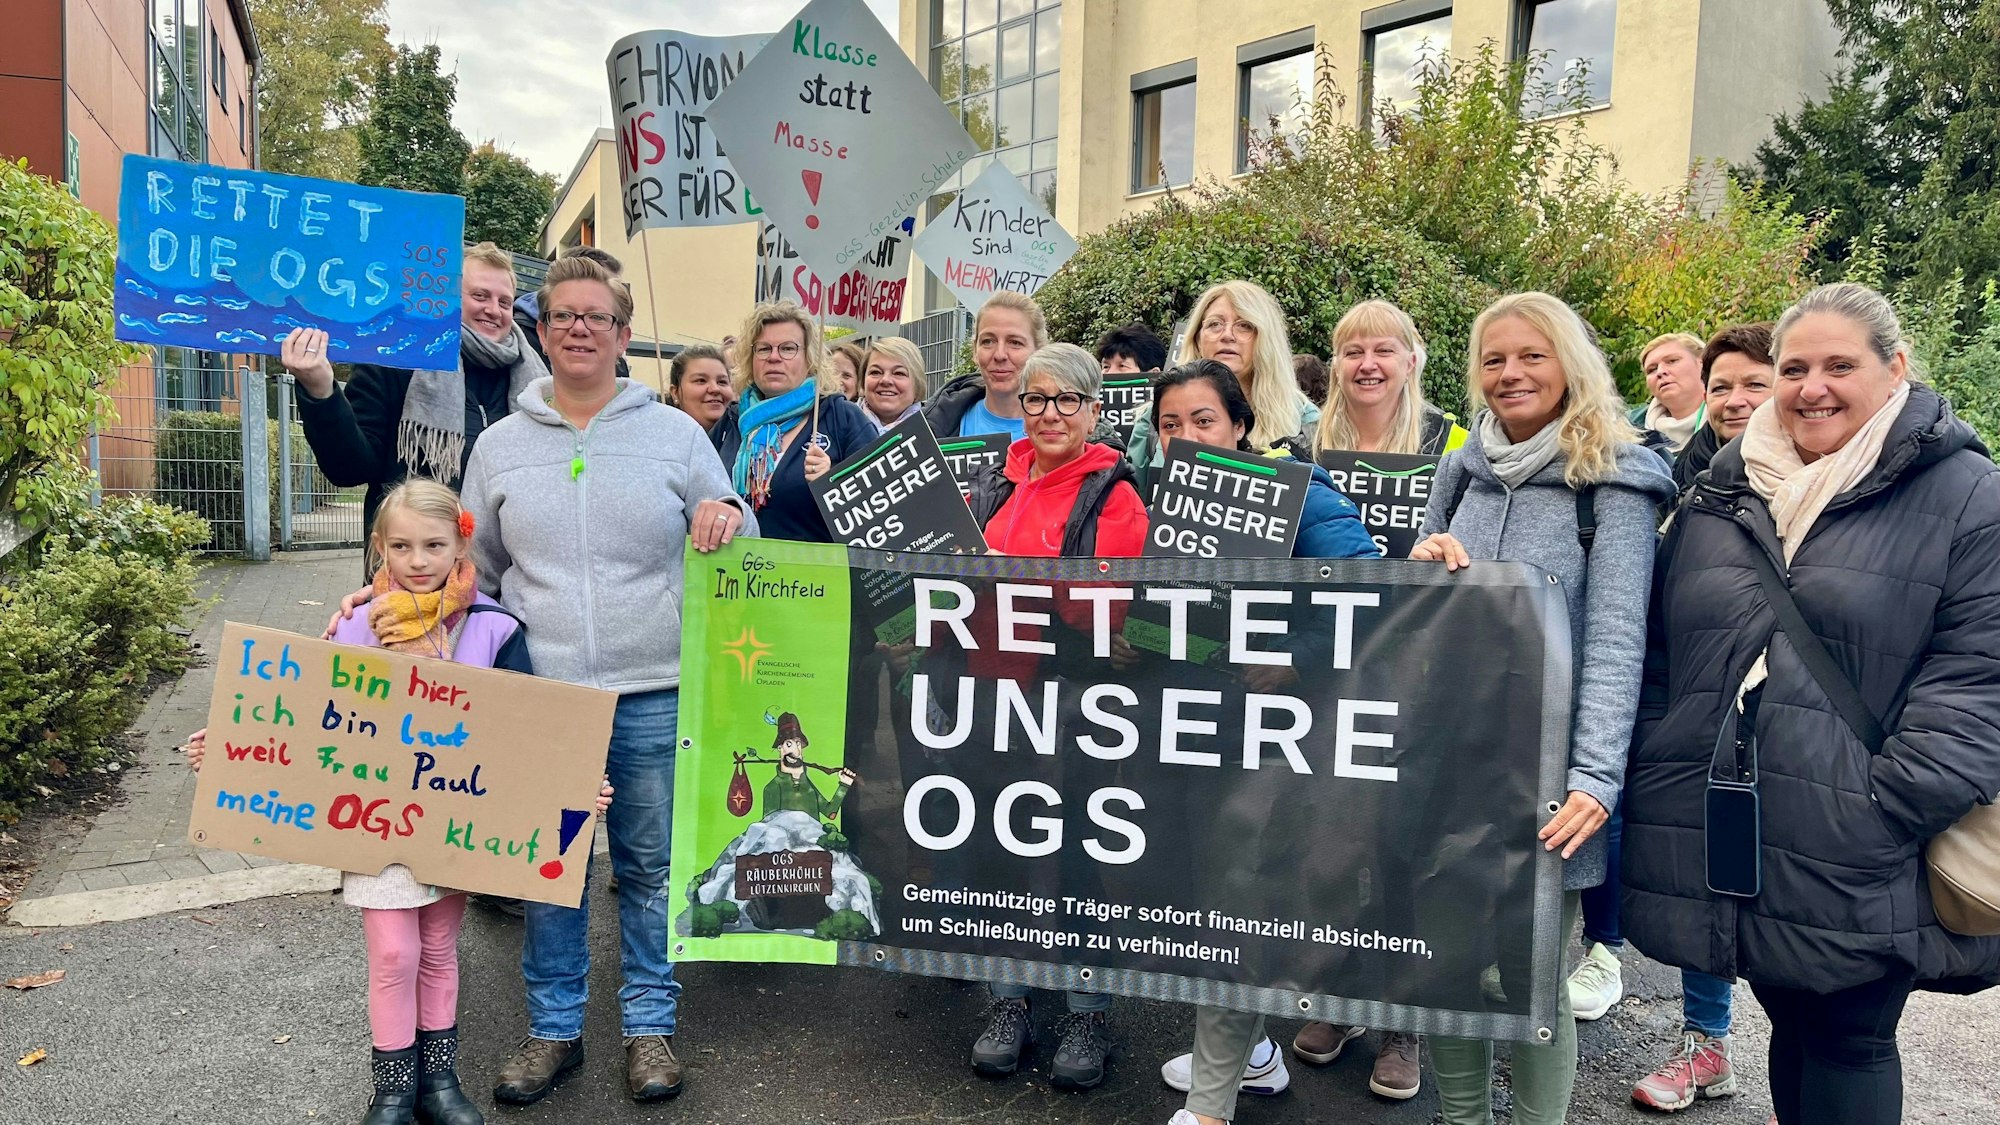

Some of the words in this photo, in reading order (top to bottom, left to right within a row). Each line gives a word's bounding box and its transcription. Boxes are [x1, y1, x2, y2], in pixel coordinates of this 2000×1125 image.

[793, 19, 877, 67] Klasse
[800, 73, 871, 114] statt
[675, 110, 706, 160] IST
[774, 120, 848, 160] Masse
[147, 170, 383, 242] RETTET
[679, 166, 736, 221] FÜR
[954, 194, 1050, 238] Kinder
[149, 227, 238, 283] DIE
[270, 247, 389, 308] OGS
[403, 241, 448, 267] SOS
[1031, 240, 1057, 255] OGS
[402, 268, 449, 295] SOS
[945, 256, 1048, 294] MEHRWERT
[402, 292, 448, 319] SOS
[822, 435, 919, 513] RETTET
[833, 456, 942, 535] UNSERE
[1168, 459, 1290, 507] RETTET
[1329, 470, 1435, 498] RETTE
[910, 531, 935, 548] Träger
[1154, 524, 1219, 558] OGS
[1161, 491, 1289, 543] UNSERE
[715, 568, 738, 600] Im
[746, 572, 824, 599] Kirchfeld
[913, 577, 1379, 669] RETTET
[239, 640, 301, 681] Ich
[331, 654, 391, 700] bin
[408, 665, 472, 711] hier,
[232, 693, 295, 727] ich
[321, 700, 377, 738] bin
[400, 714, 470, 748] laut
[909, 673, 1399, 782] UNSERE
[225, 737, 292, 766] weil
[317, 746, 390, 783] Frau
[411, 751, 488, 796] Paul
[216, 790, 316, 831] meine
[327, 793, 424, 841] OGS
[902, 774, 1147, 864] OGS
[746, 866, 823, 882] RÄUBERHÖHLE
[772, 852, 794, 866] OGS
[750, 883, 820, 895] LÜTZENKIRCHEN
[901, 918, 933, 932] um
[939, 917, 1080, 949] Schließungen
[1086, 934, 1111, 949] zu
[1117, 935, 1240, 964] verhindern!
[903, 883, 1056, 916] Gemeinnützige
[1062, 897, 1132, 919] Träger
[1138, 905, 1202, 926] sofort
[1208, 911, 1305, 940] finanziell
[1312, 925, 1433, 959] absichern,
